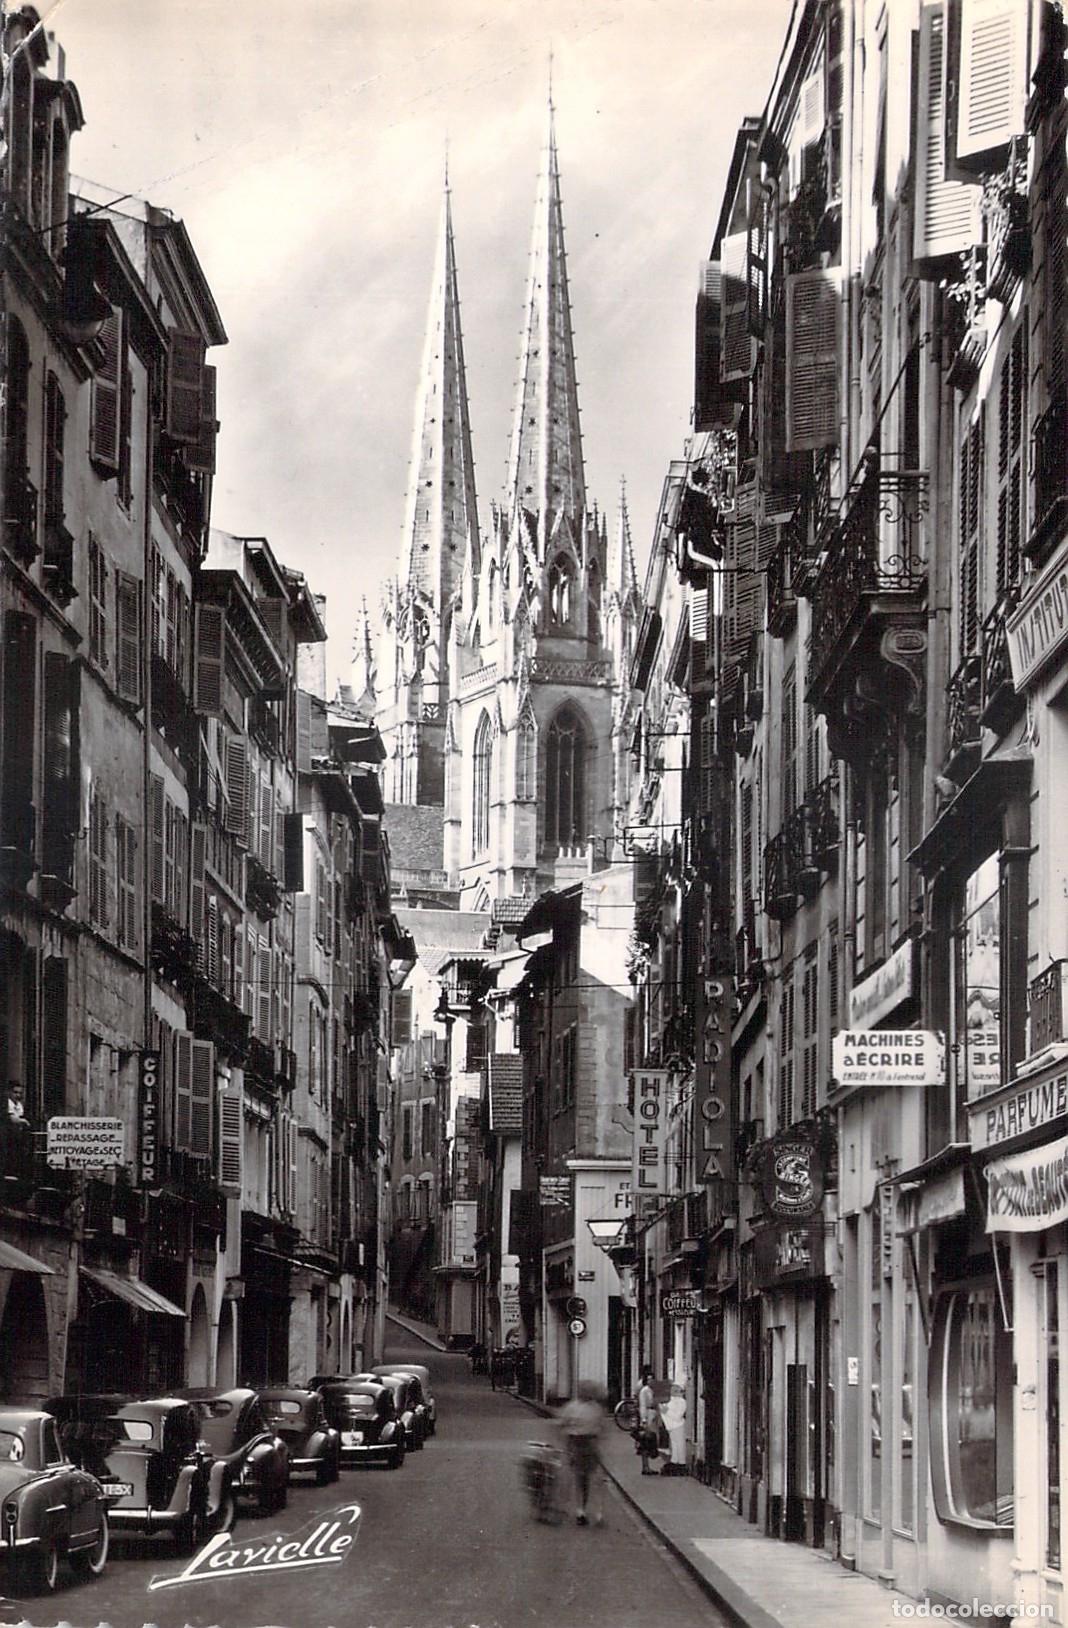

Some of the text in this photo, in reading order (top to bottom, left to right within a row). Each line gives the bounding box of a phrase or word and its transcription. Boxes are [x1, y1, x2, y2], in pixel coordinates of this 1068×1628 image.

[844, 1034, 925, 1047] MACHINES
[51, 1121, 122, 1130] BLANCHISSERIE
[142, 1058, 156, 1181] COIFFEUR
[56, 1133, 116, 1143] REPASSAGE
[638, 1077, 660, 1188] HOTEL
